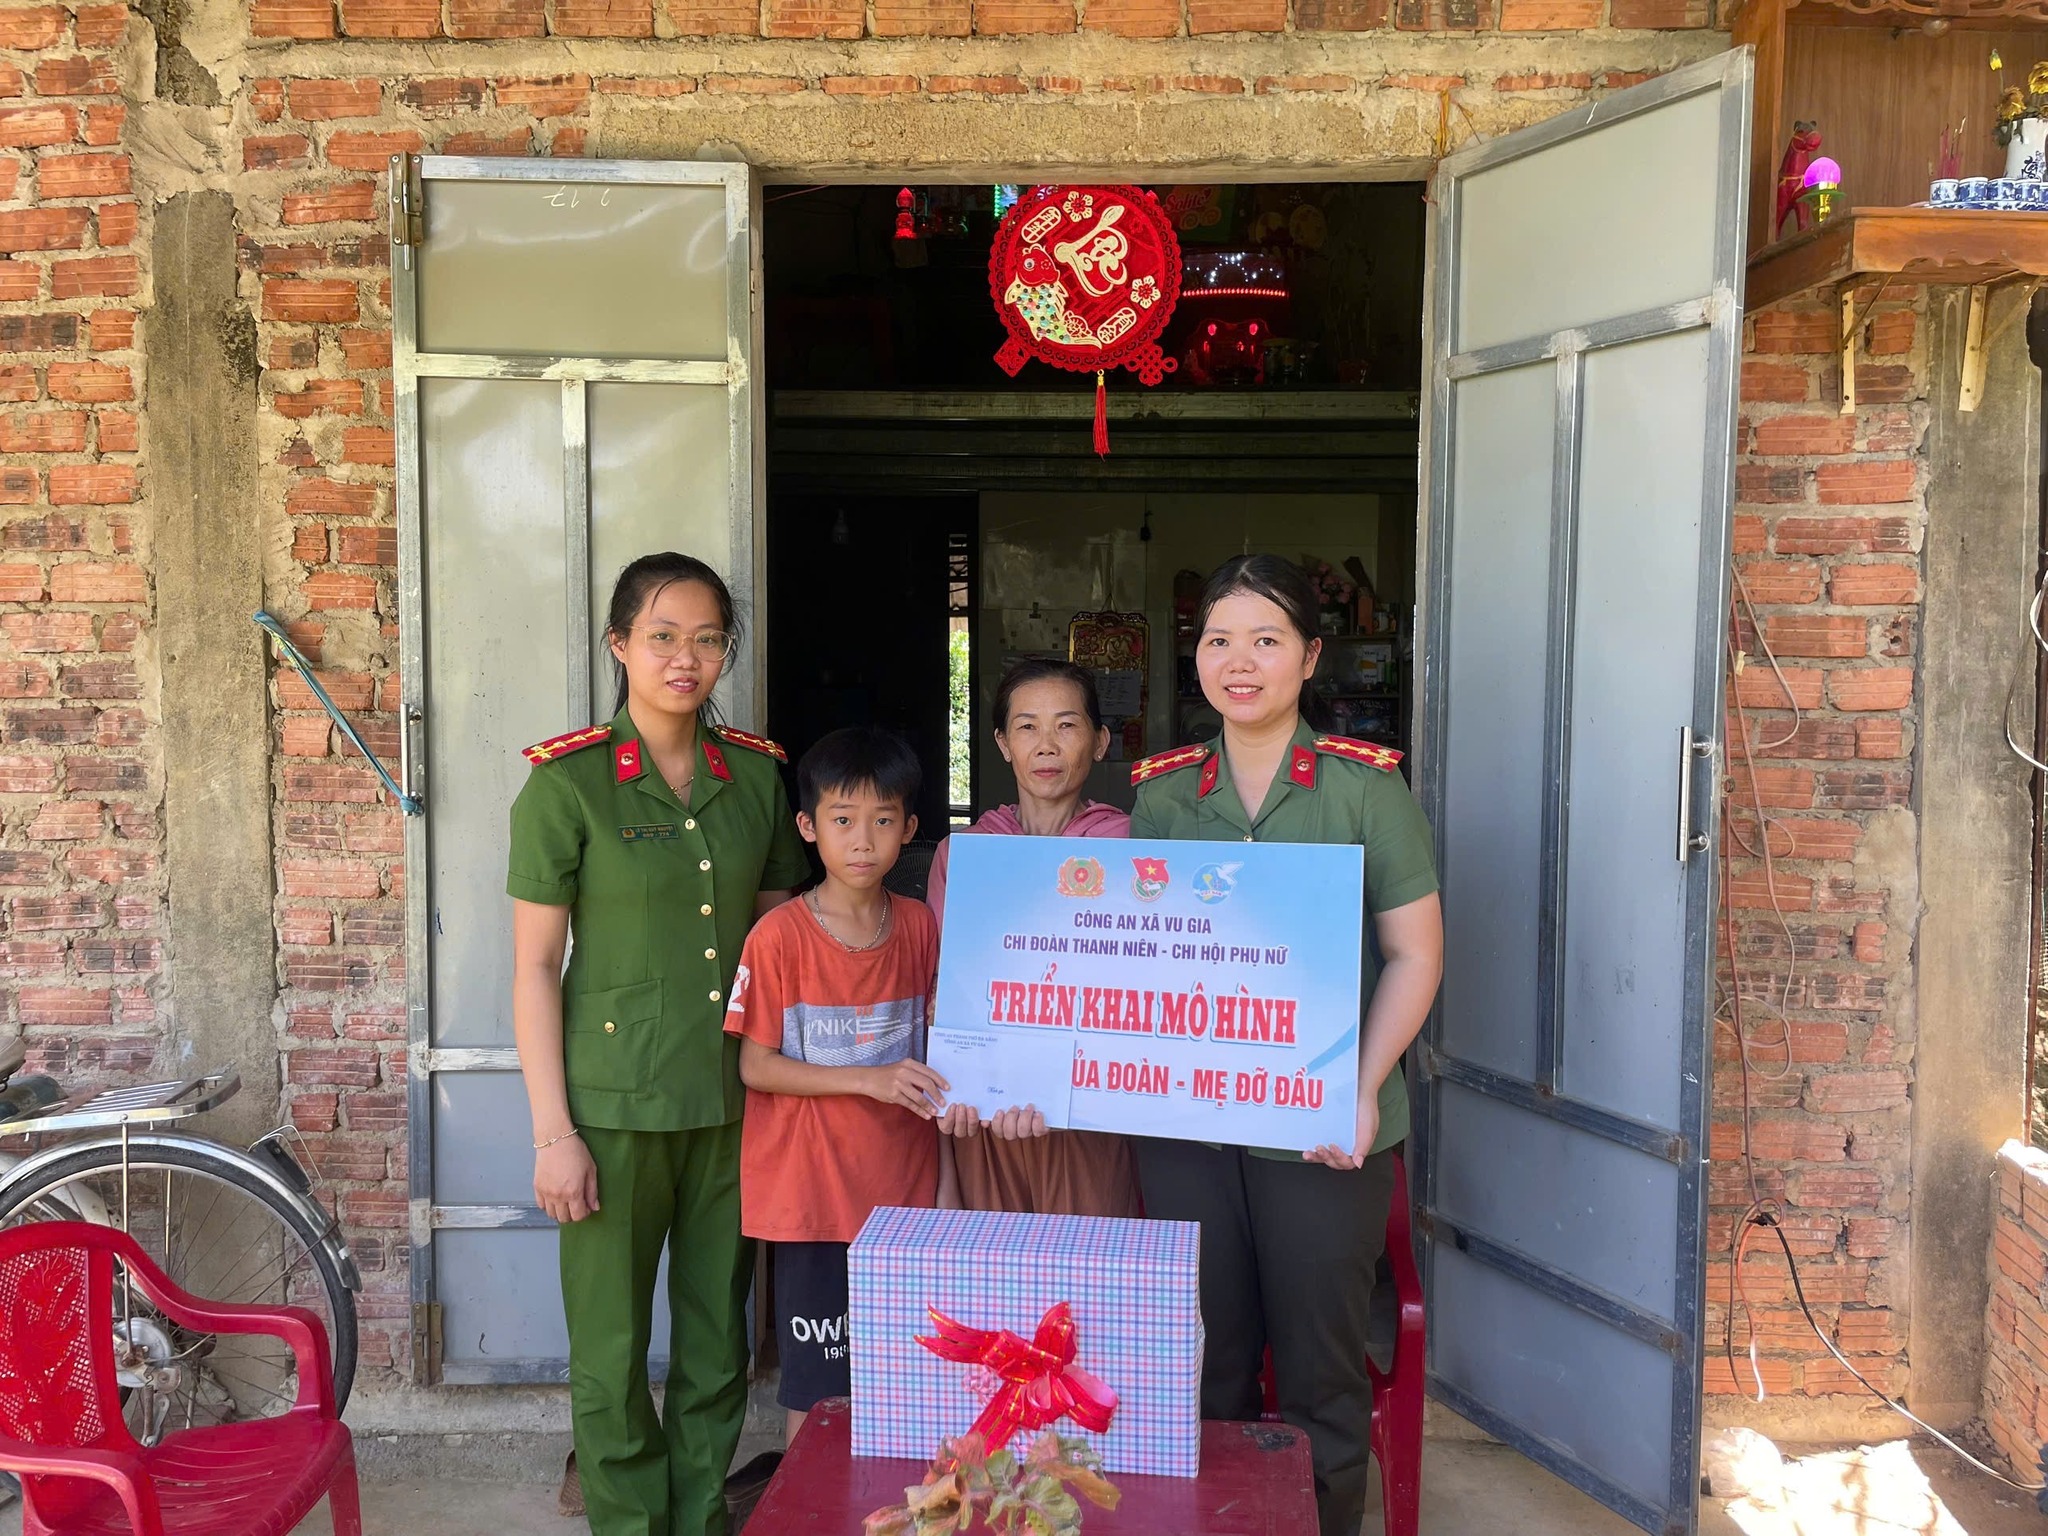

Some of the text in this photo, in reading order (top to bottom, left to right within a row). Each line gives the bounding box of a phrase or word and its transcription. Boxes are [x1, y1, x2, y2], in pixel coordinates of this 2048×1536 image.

[1074, 910, 1211, 934] CÔNG AN XÃ VU GIA
[1003, 934, 1026, 950] CHI
[1030, 933, 1068, 953] ĐOÀN
[1073, 938, 1119, 956] THANH
[1123, 937, 1157, 958] NIÊN
[1172, 943, 1196, 960] CHI
[1201, 942, 1225, 965] HỘI
[1230, 947, 1260, 967] PHỤ
[1265, 945, 1288, 965] NỮ
[991, 963, 1297, 1043] TRIỂN KHAI MÔ HÌNH
[1107, 1057, 1170, 1095] ĐOÀN
[1193, 1068, 1228, 1108] MẸ
[1235, 1067, 1268, 1104] ĐỠ
[1274, 1066, 1324, 1110] ĐẦU
